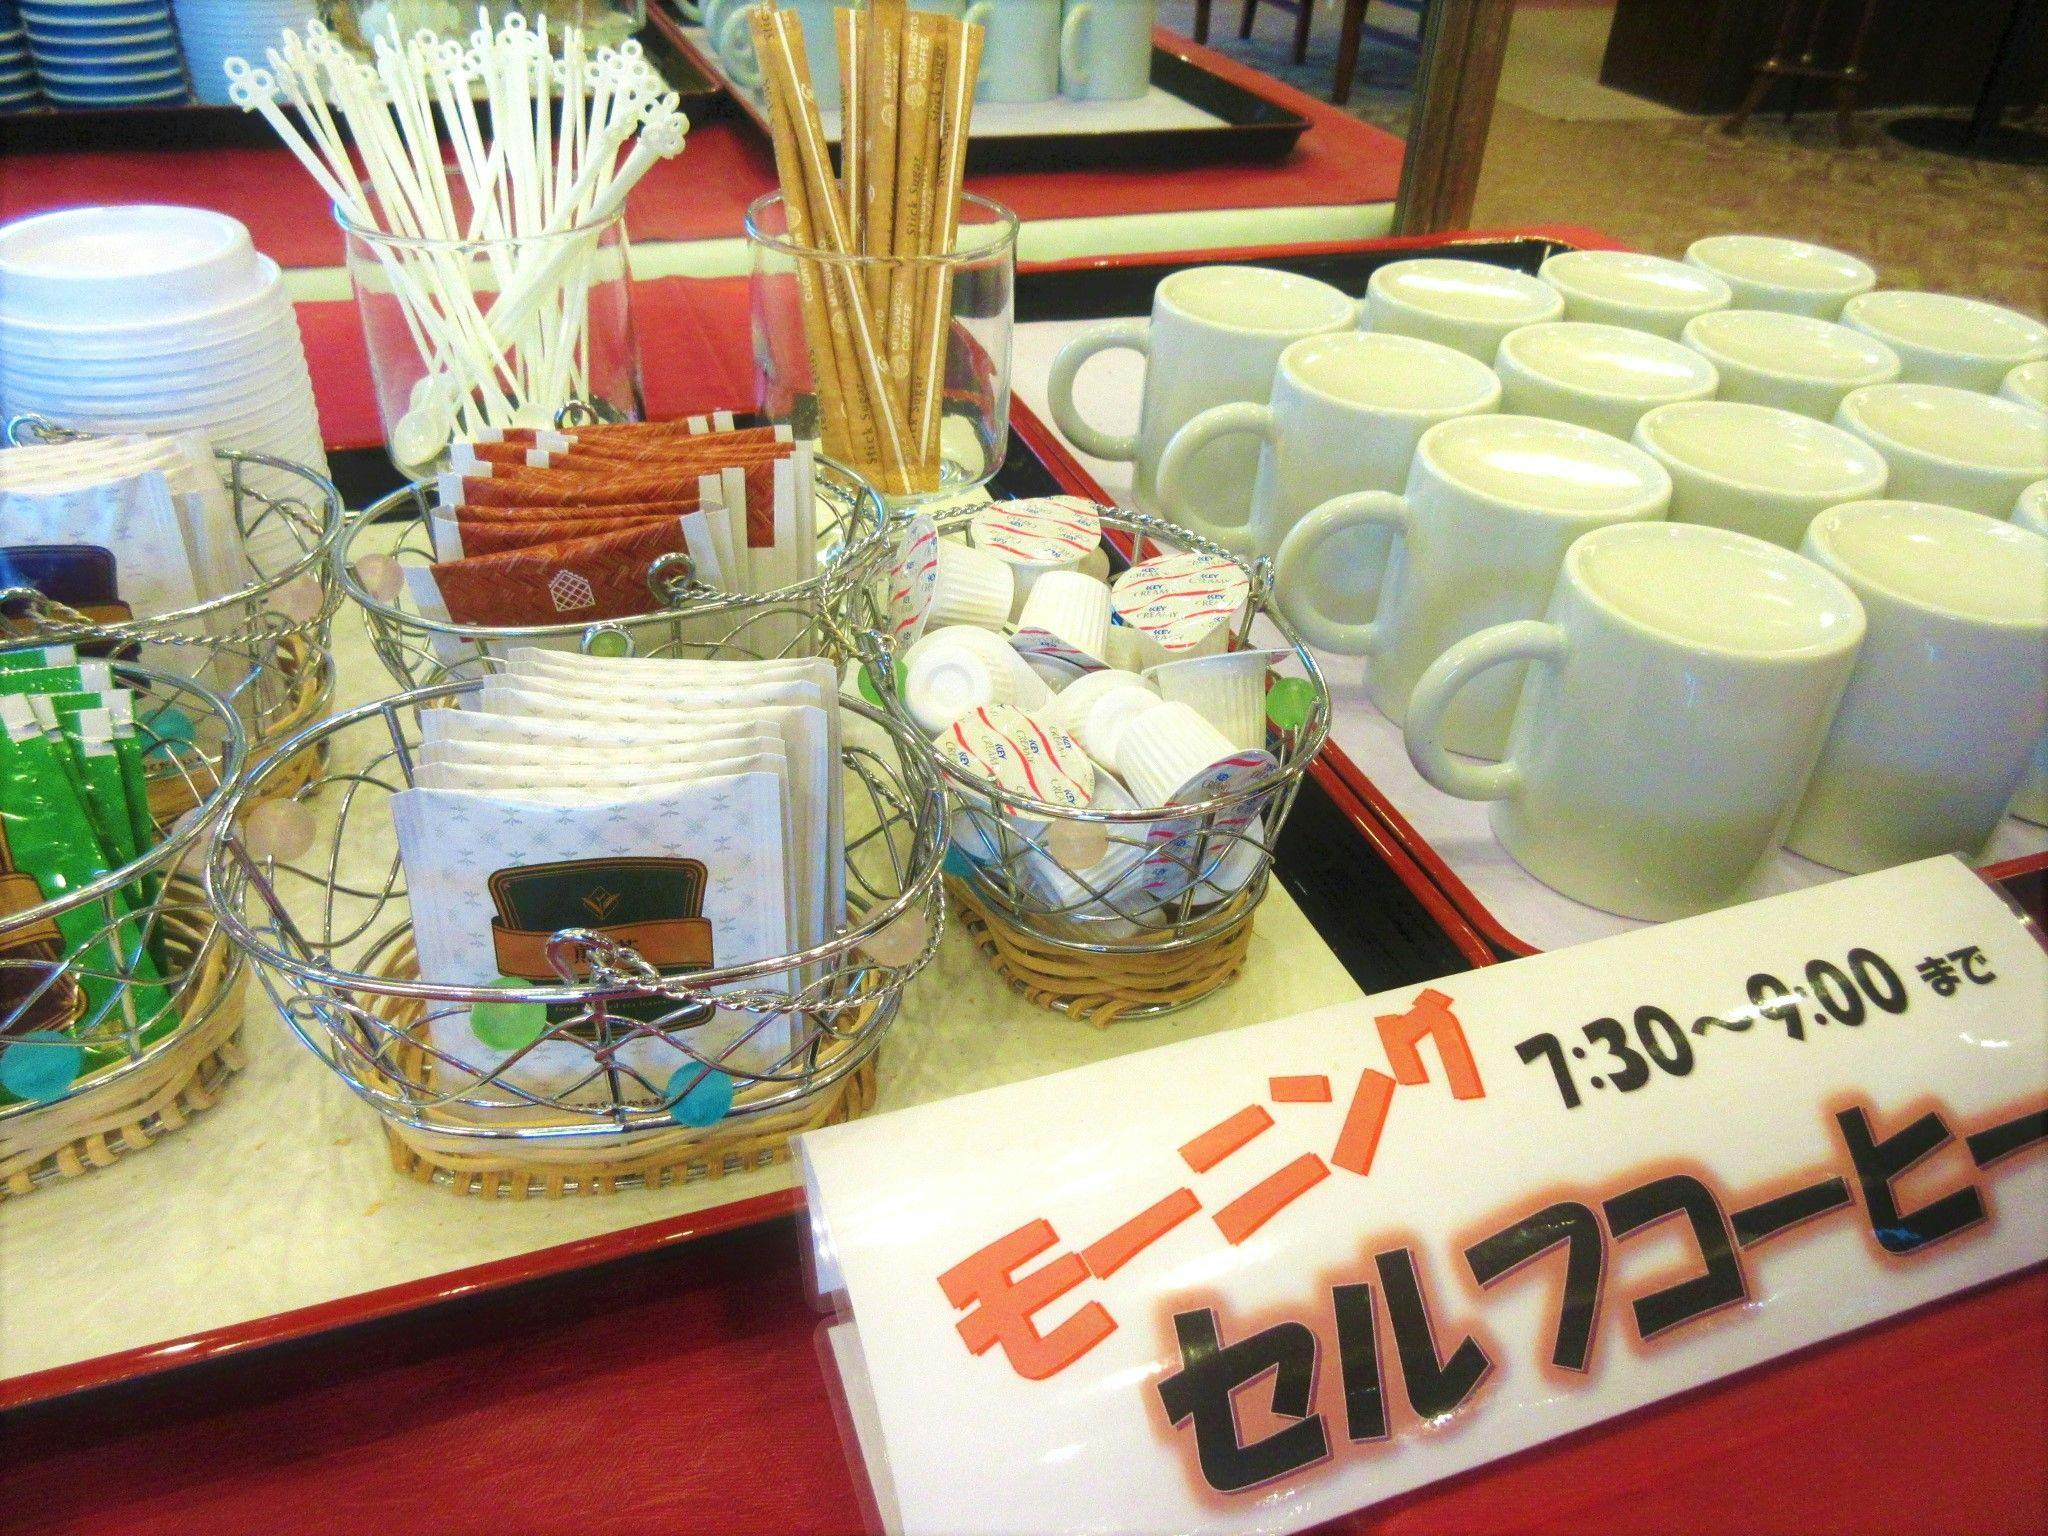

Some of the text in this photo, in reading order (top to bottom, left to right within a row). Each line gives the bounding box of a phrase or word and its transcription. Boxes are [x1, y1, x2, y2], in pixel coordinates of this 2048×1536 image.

[958, 751, 970, 767] KEY
[995, 743, 1007, 760] KEY
[1028, 738, 1040, 755] KEY
[1917, 946, 1997, 997] まで
[936, 987, 1486, 1382] モーニング
[1157, 1104, 2048, 1494] セルフコーヒー
